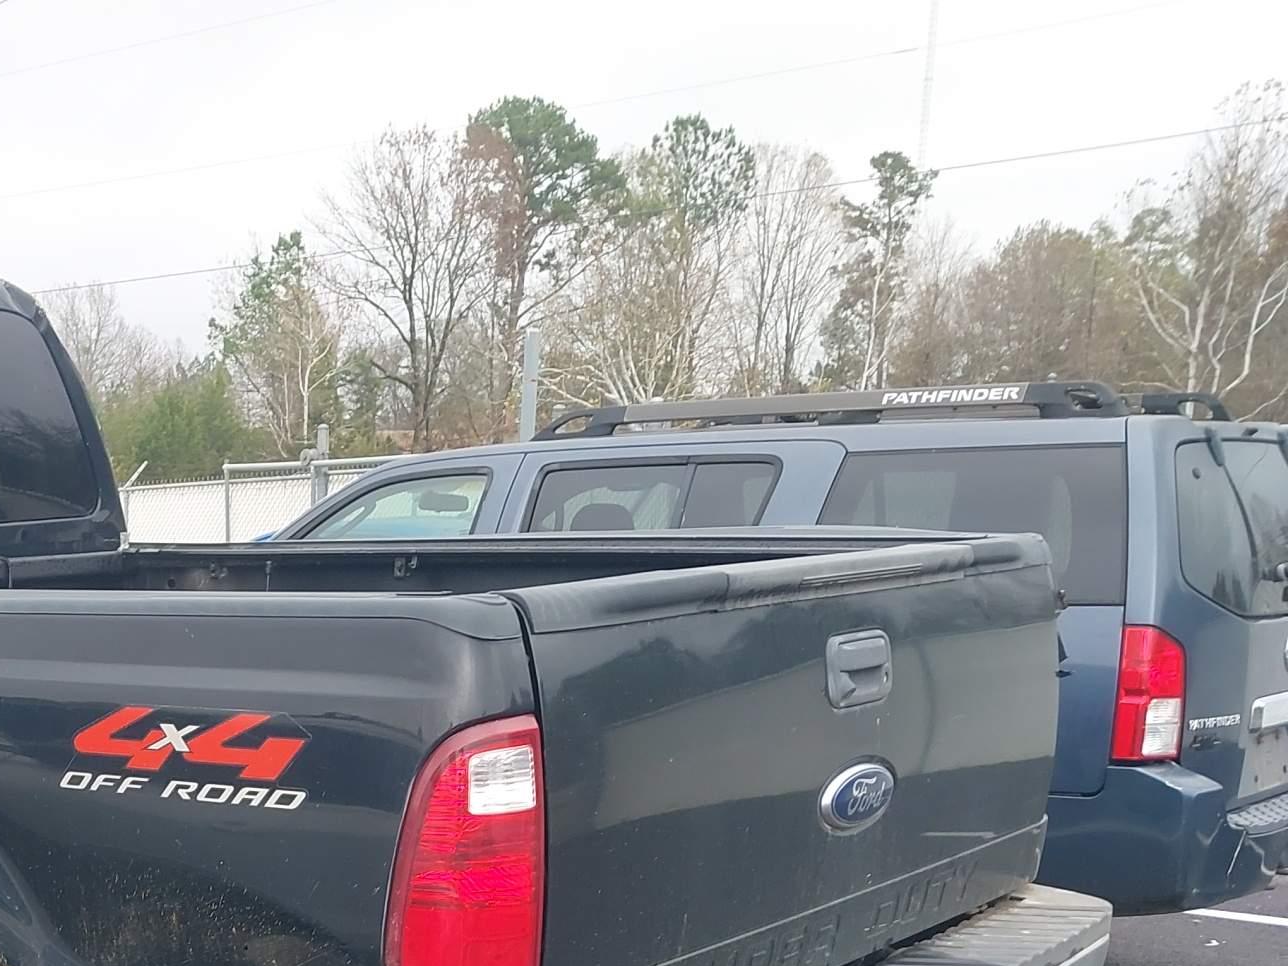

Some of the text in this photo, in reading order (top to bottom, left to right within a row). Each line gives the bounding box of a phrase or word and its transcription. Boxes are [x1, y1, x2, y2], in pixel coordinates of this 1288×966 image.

[881, 387, 1020, 405] PATHFINDER
[1188, 713, 1241, 731] PATHFINDER
[59, 770, 308, 810] OFF ROAD
[847, 775, 886, 816] Ford
